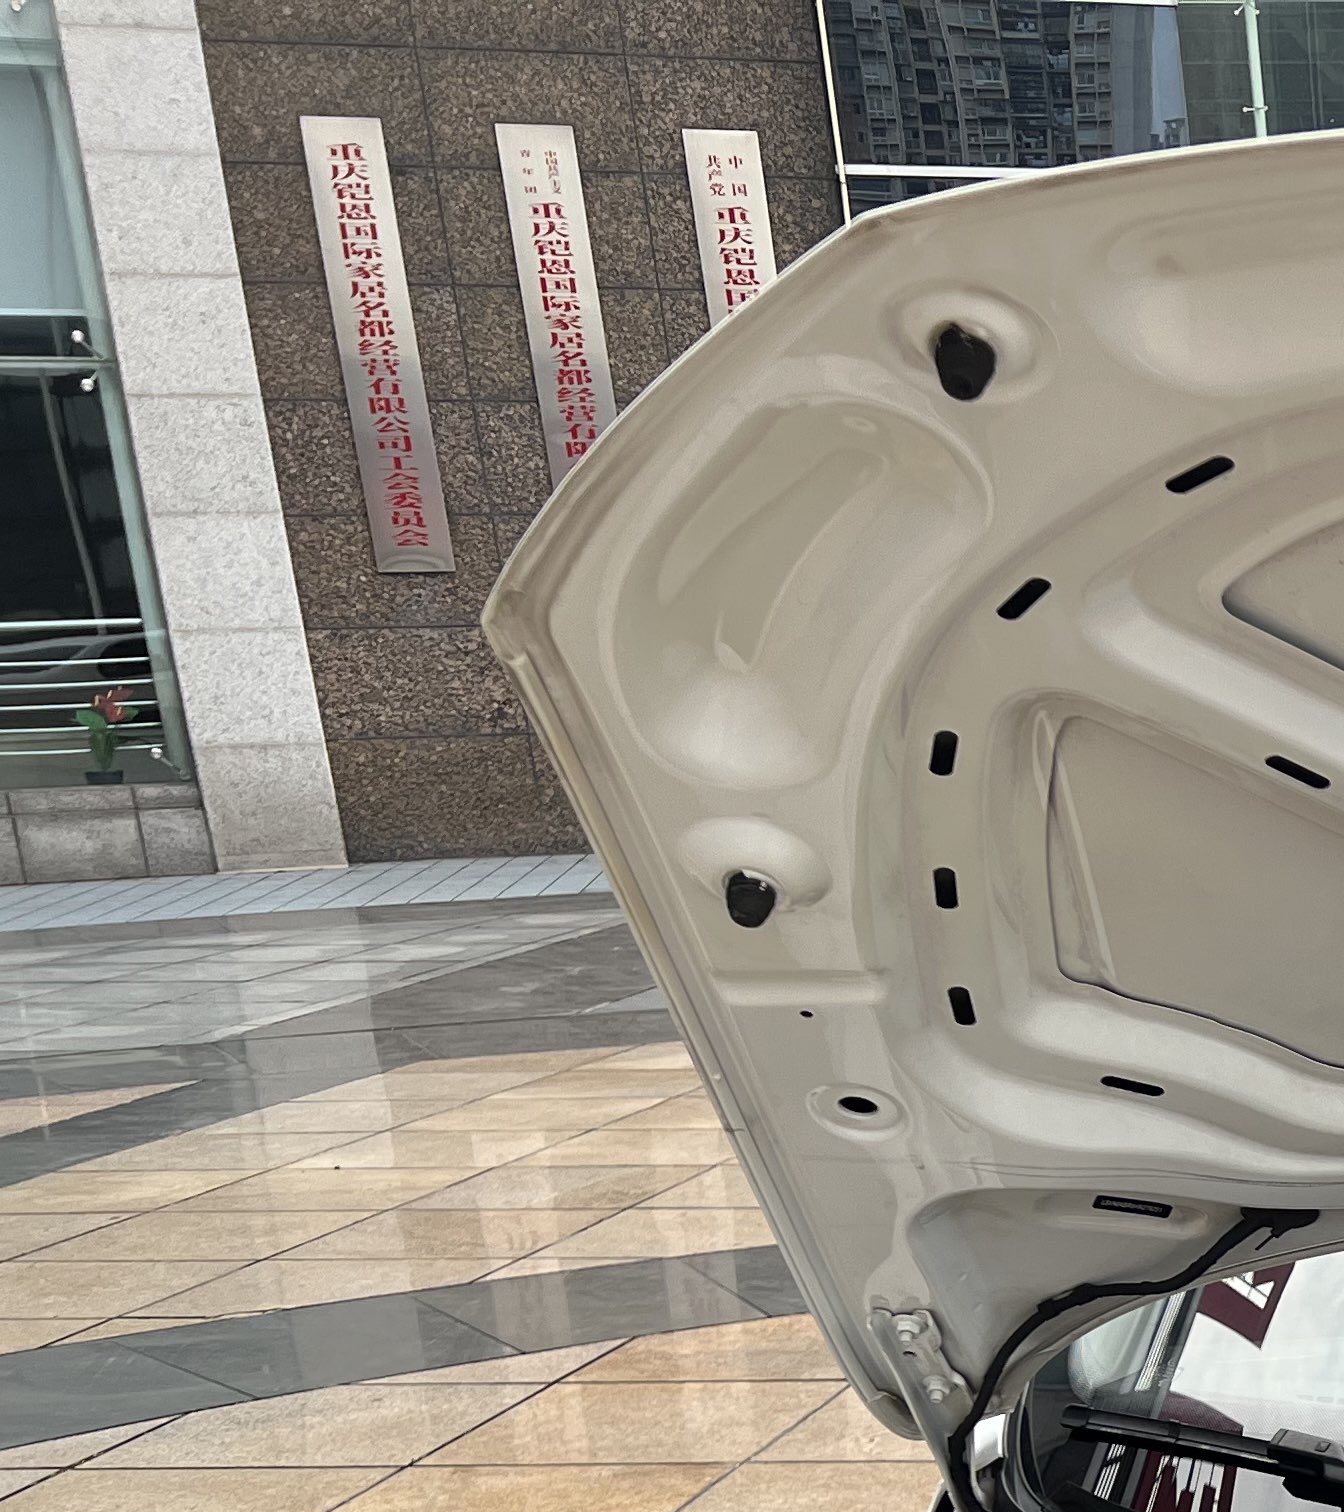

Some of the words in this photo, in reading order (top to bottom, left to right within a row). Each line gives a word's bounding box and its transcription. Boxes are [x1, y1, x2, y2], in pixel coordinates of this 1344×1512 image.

[714, 206, 761, 314] 重庆铠恩国
